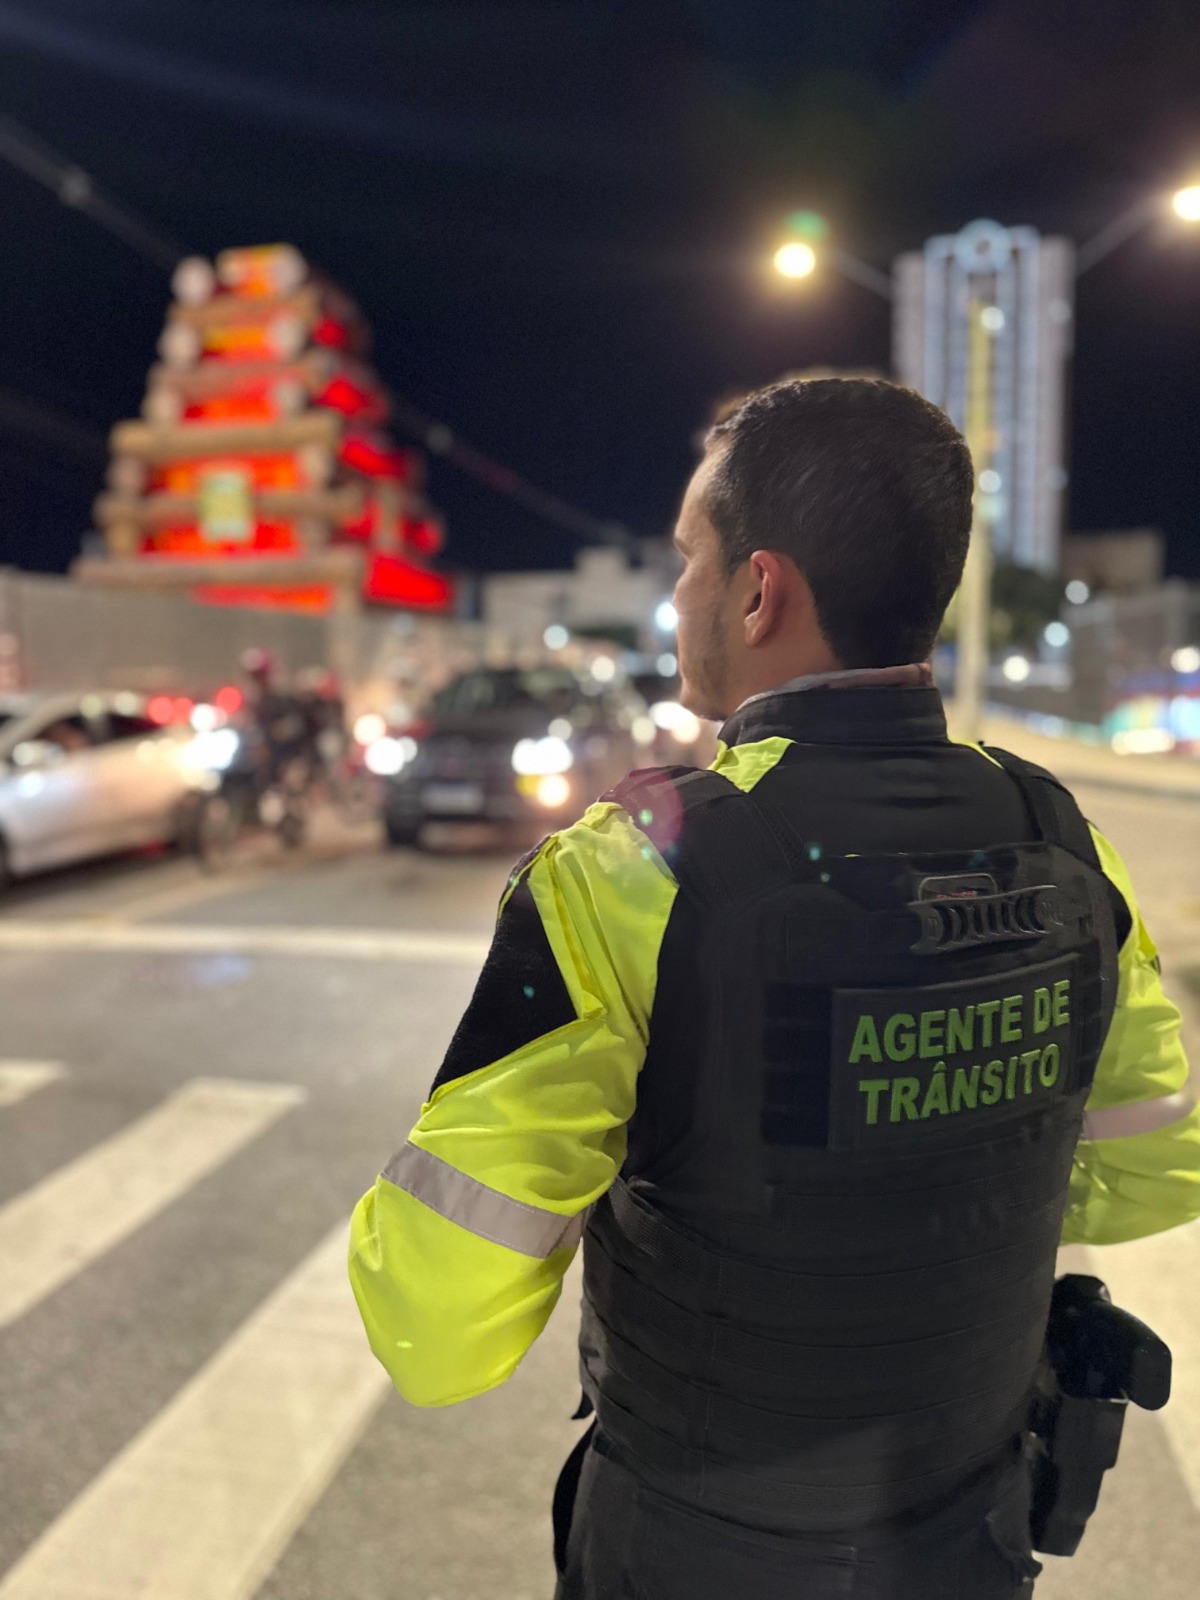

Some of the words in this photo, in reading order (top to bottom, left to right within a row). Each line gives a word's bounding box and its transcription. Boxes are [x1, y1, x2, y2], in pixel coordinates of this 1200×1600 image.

[849, 994, 1022, 1063] AGENTE
[1033, 980, 1070, 1034] DE
[858, 1043, 1060, 1124] TRÂNSITO
